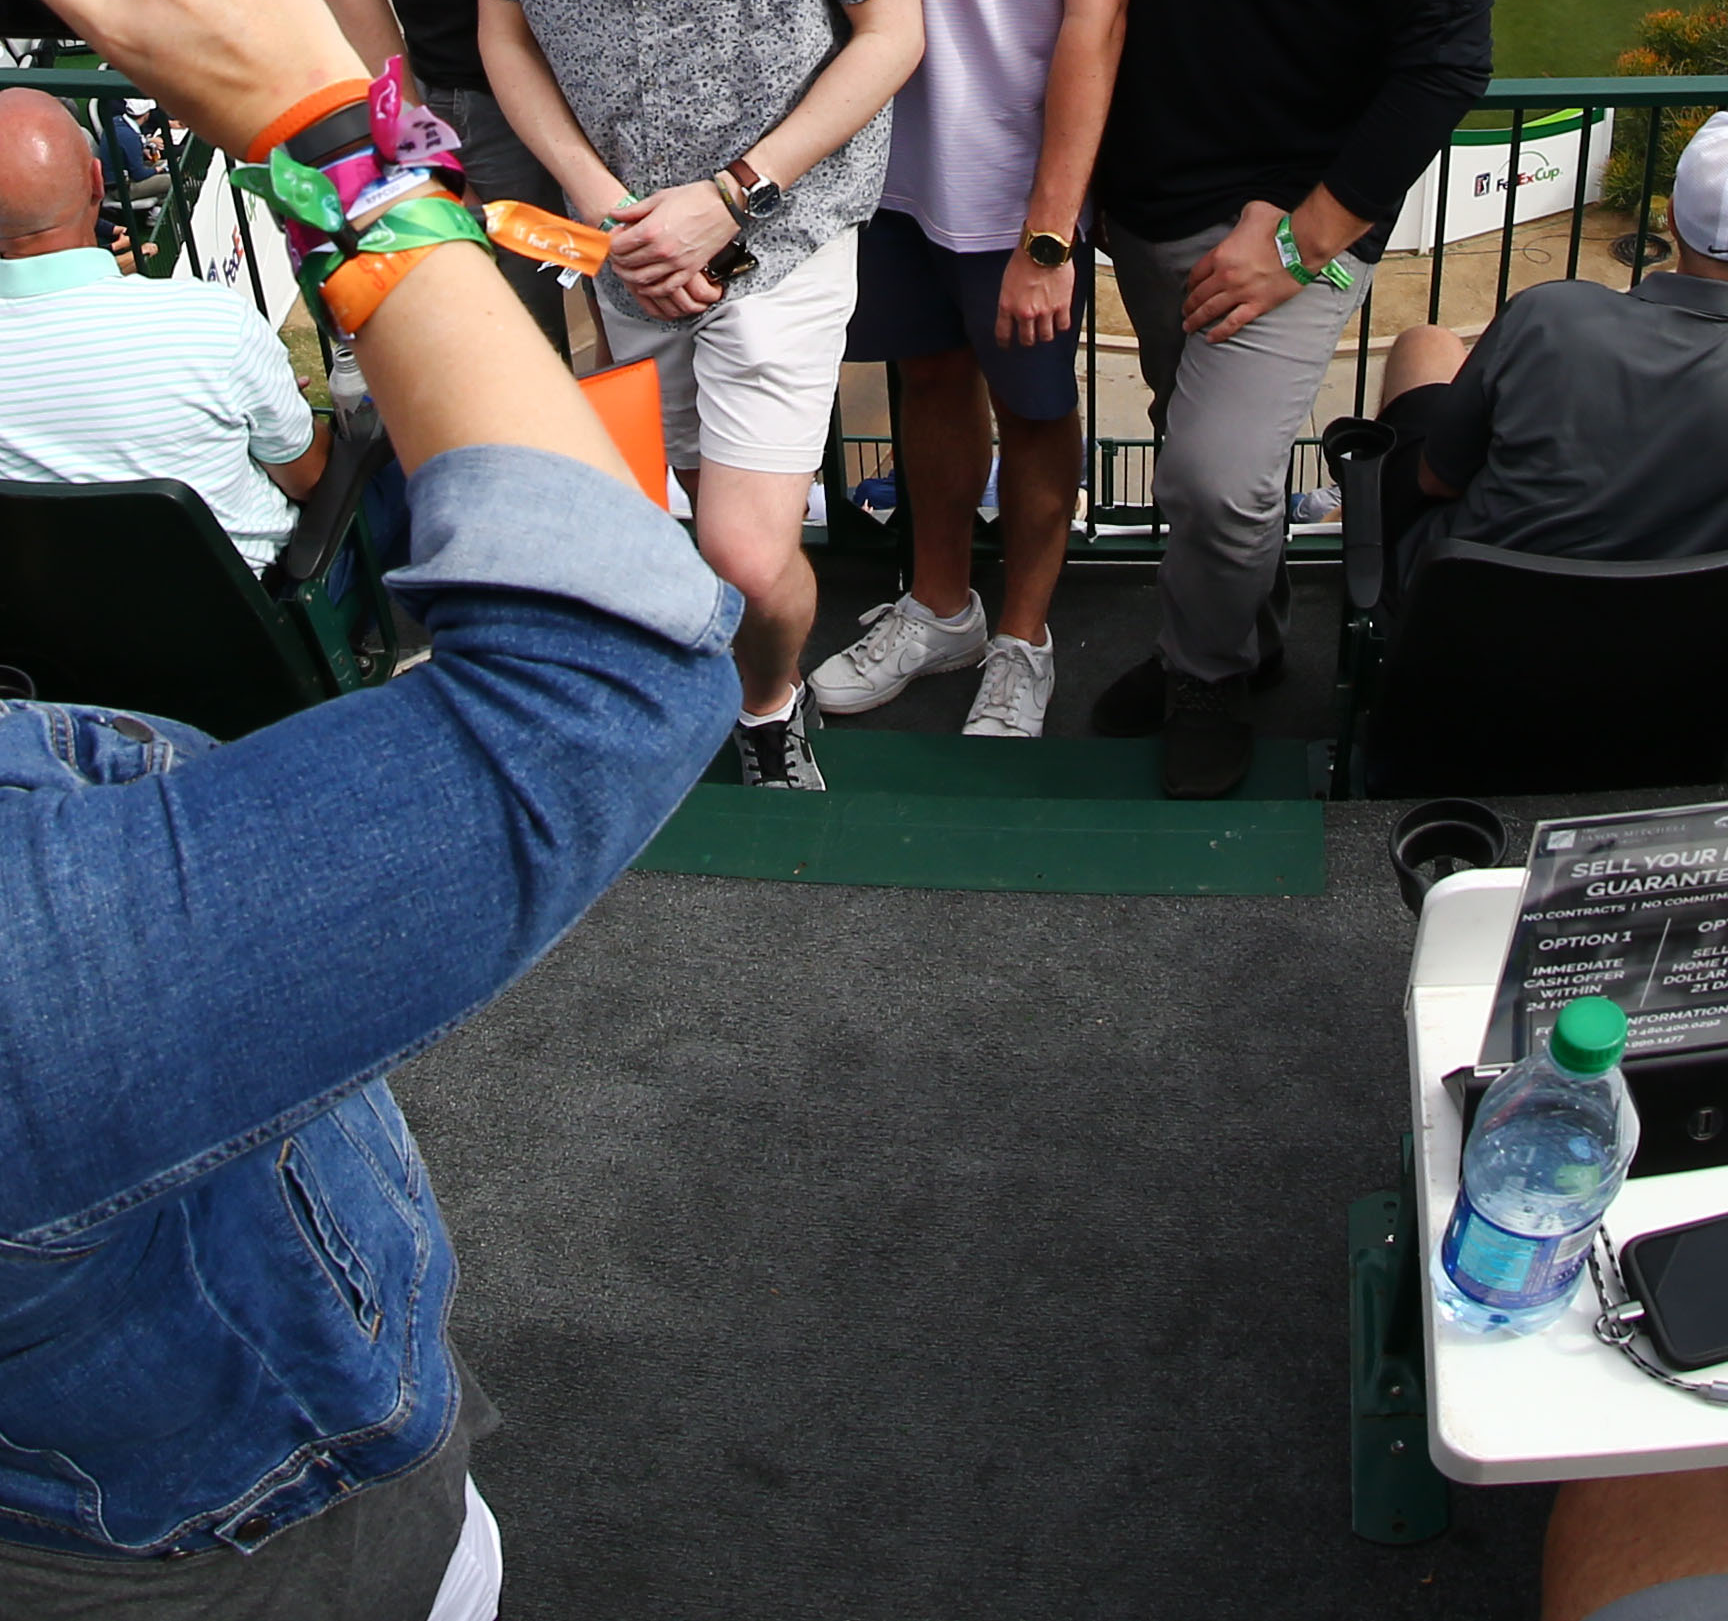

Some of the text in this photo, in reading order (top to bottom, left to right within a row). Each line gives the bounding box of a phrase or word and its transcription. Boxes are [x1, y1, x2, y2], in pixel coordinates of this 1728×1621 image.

[1495, 166, 1560, 193] FeExCup
[1571, 859, 1637, 879] SELL
[1643, 847, 1718, 870] YOUR
[1522, 912, 1544, 922] NO
[1545, 903, 1626, 920] CONTRACTS
[1641, 899, 1662, 910] NO
[1538, 931, 1633, 951] OPTION 1
[1532, 958, 1625, 977] IMMEDIATE
[1672, 958, 1720, 972] HOME
[1523, 970, 1626, 989] CASH OFFER
[1663, 970, 1727, 986] DOLLAR
[1540, 984, 1603, 999] WITHIN
[1690, 983, 1709, 994] 21
[1526, 1002, 1547, 1013] 24
